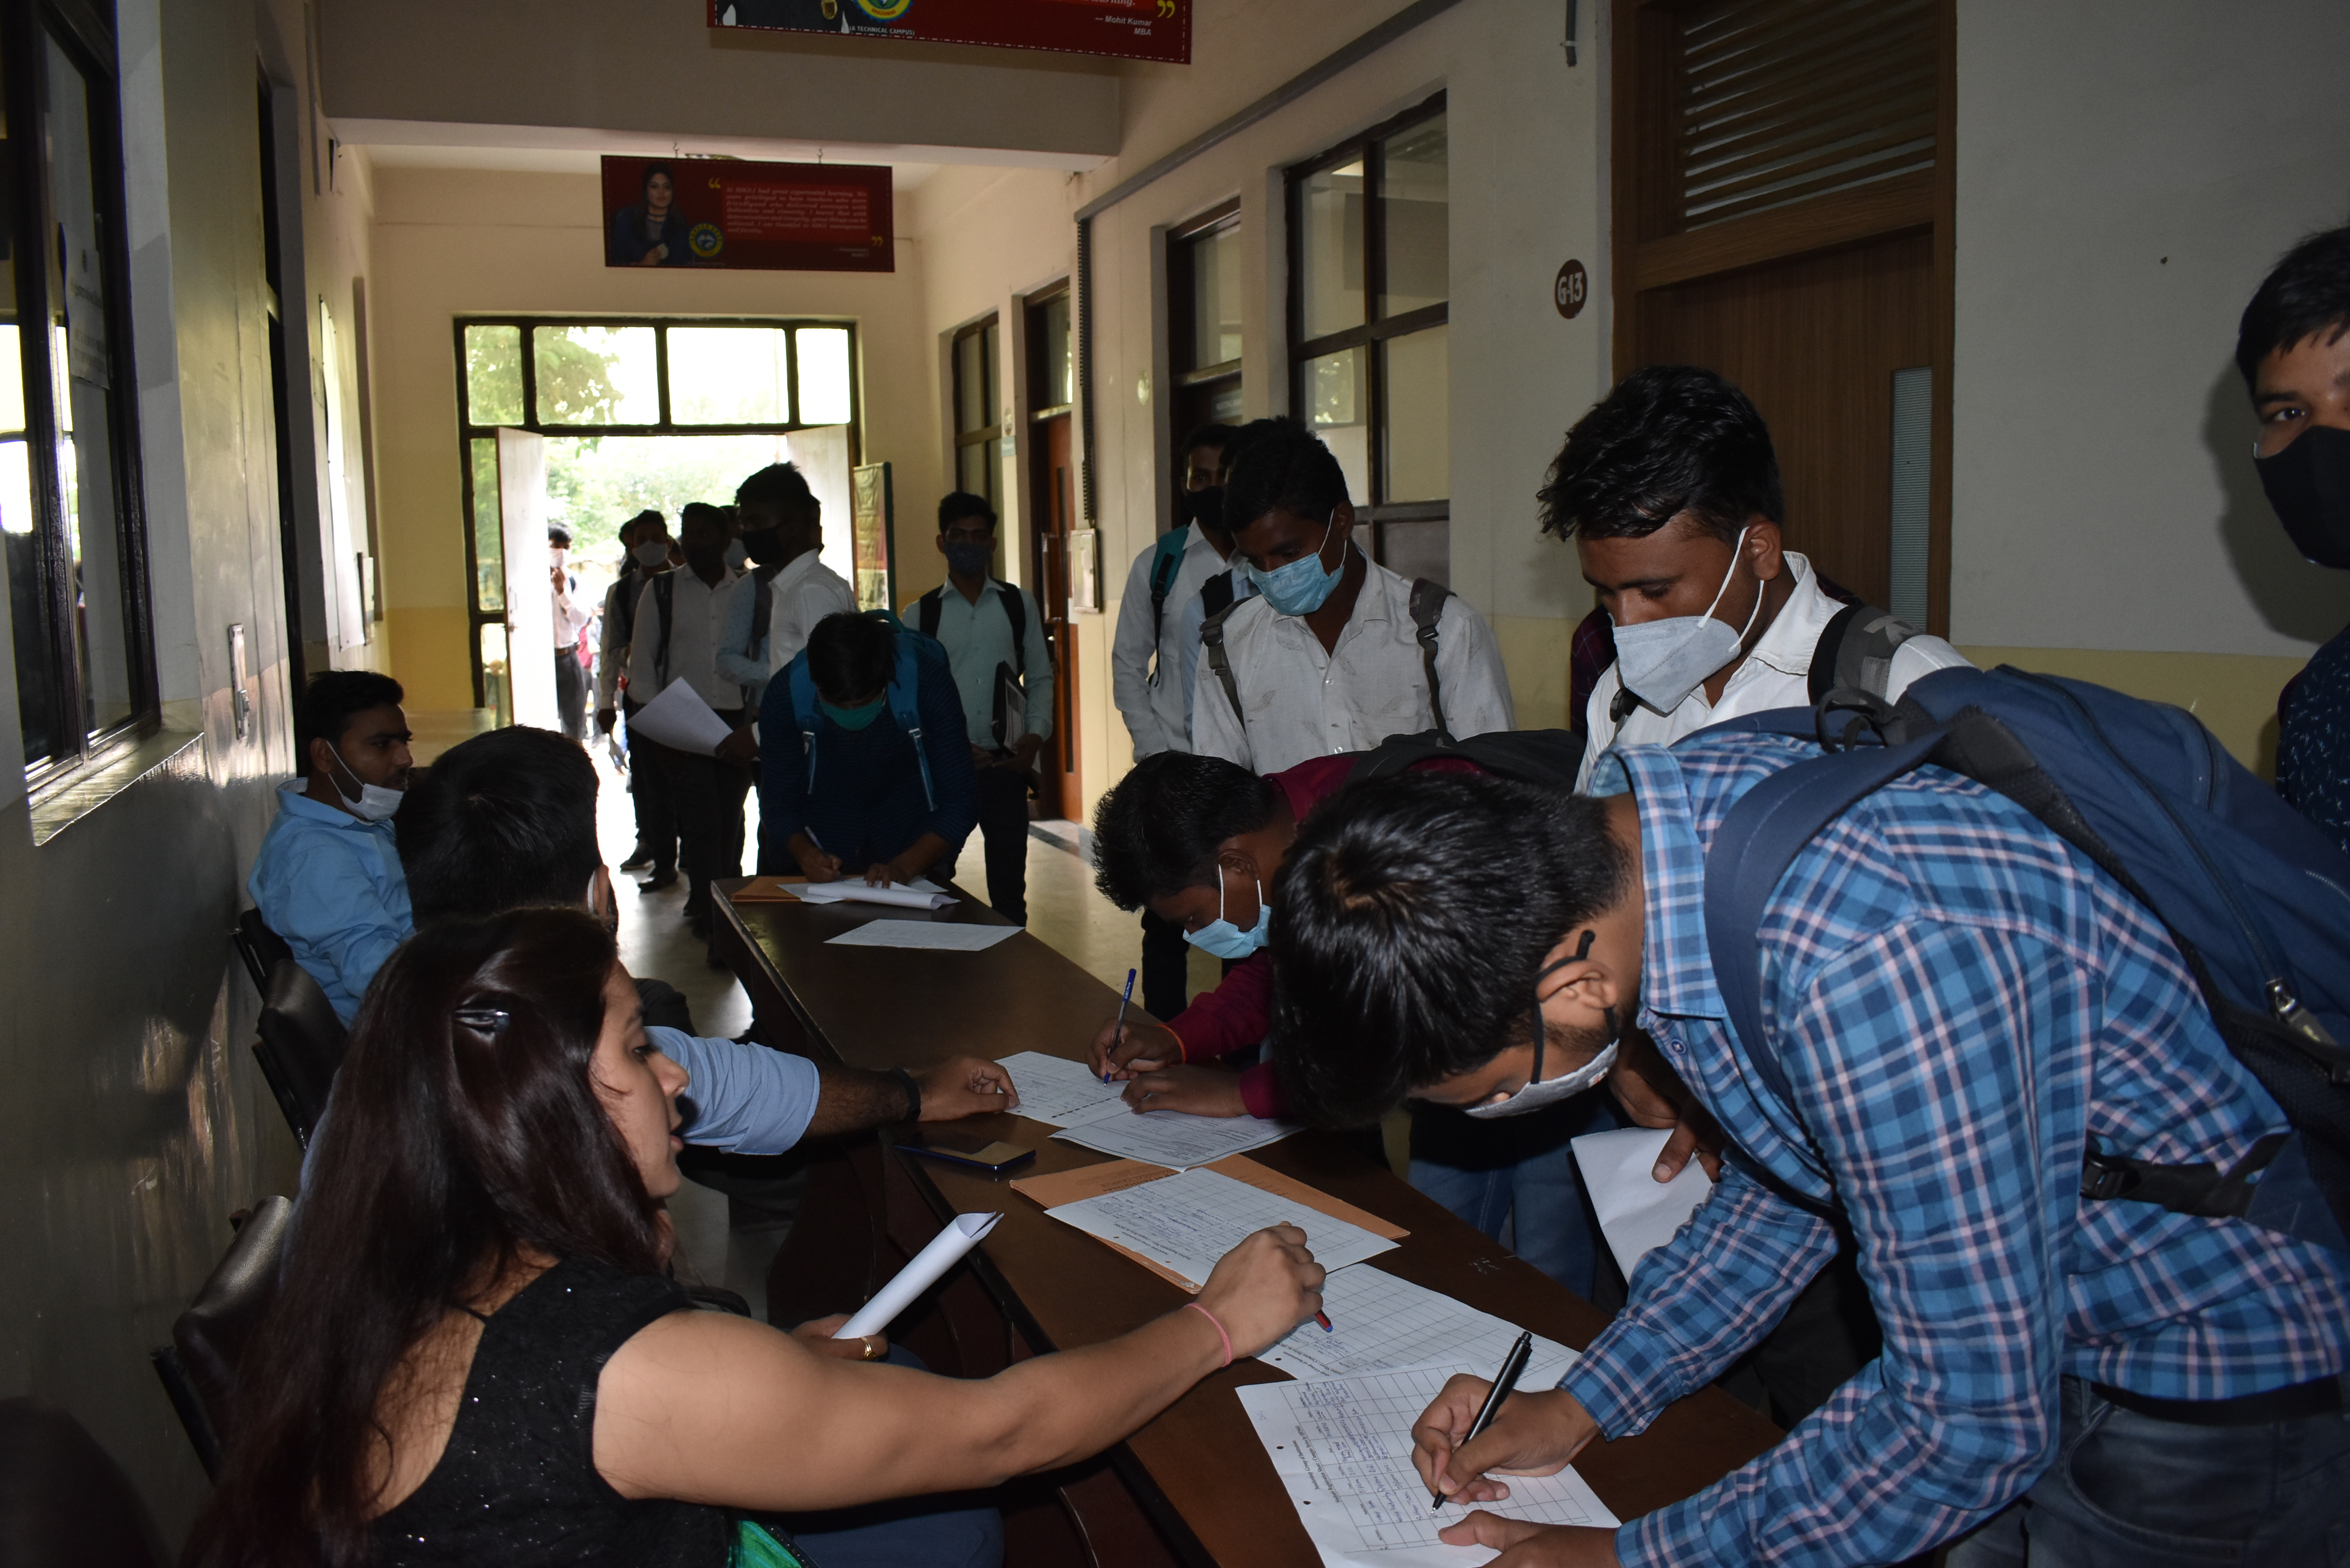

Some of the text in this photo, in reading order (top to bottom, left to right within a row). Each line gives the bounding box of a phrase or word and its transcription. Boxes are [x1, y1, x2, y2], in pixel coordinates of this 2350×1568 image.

[1105, 15, 1152, 26] Mohit Kumar
[1308, 1448, 1318, 1460] Campus
[1301, 1460, 1310, 1471] Group
[1315, 1463, 1323, 1471] Sheet
[1320, 1472, 1334, 1490] Registration
